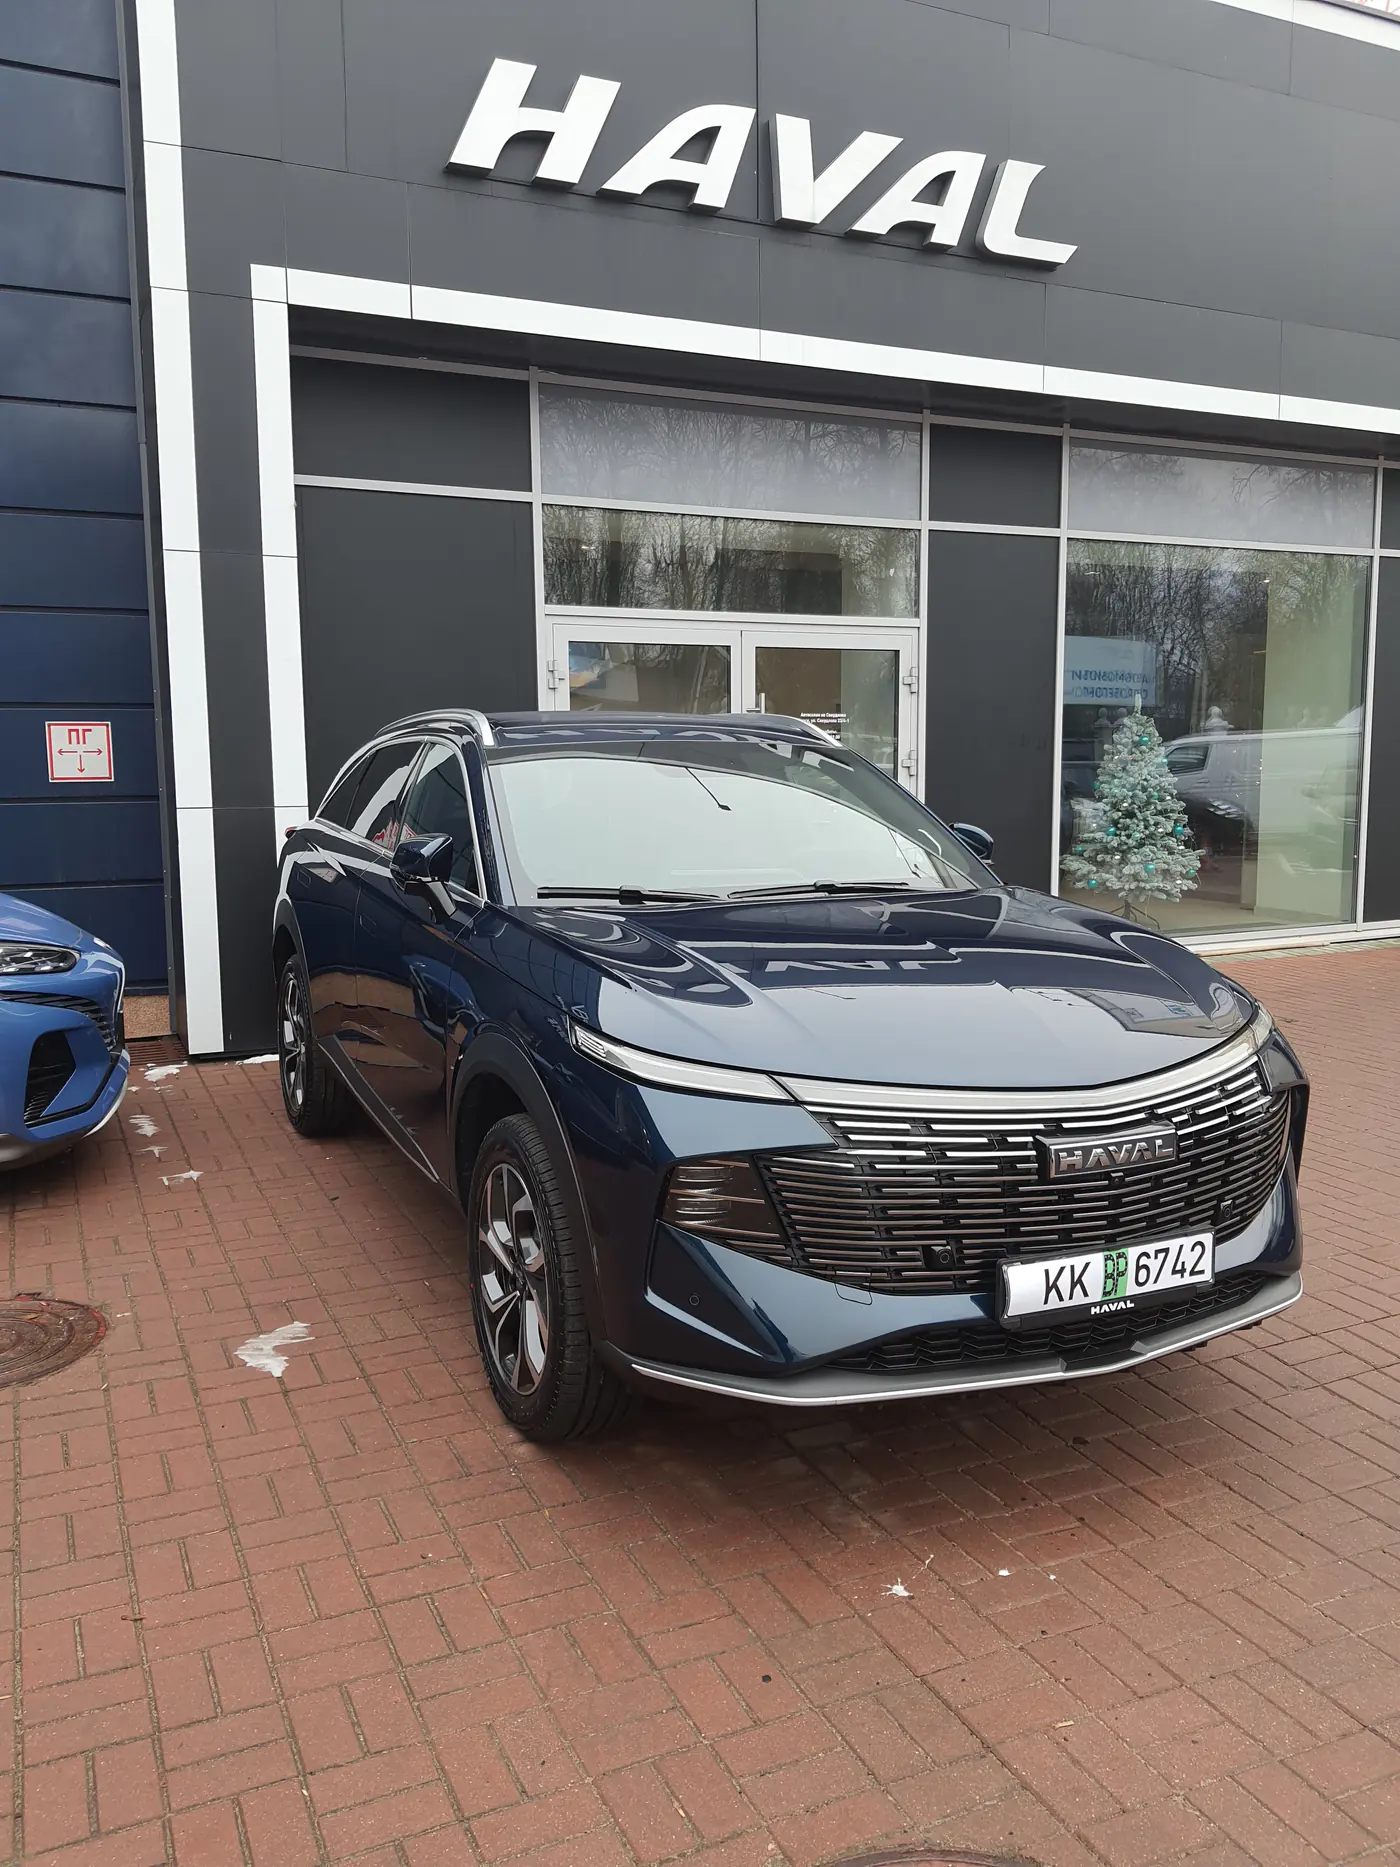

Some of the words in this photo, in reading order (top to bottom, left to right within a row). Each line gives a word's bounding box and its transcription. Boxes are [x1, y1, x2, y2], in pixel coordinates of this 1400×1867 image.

[445, 57, 1079, 269] HAVAL
[67, 728, 93, 745] ПГ
[1058, 1138, 1174, 1172] HAVAL
[1042, 1261, 1091, 1306] KK
[1133, 1240, 1206, 1288] 6742
[1090, 1300, 1135, 1315] HAVAL
